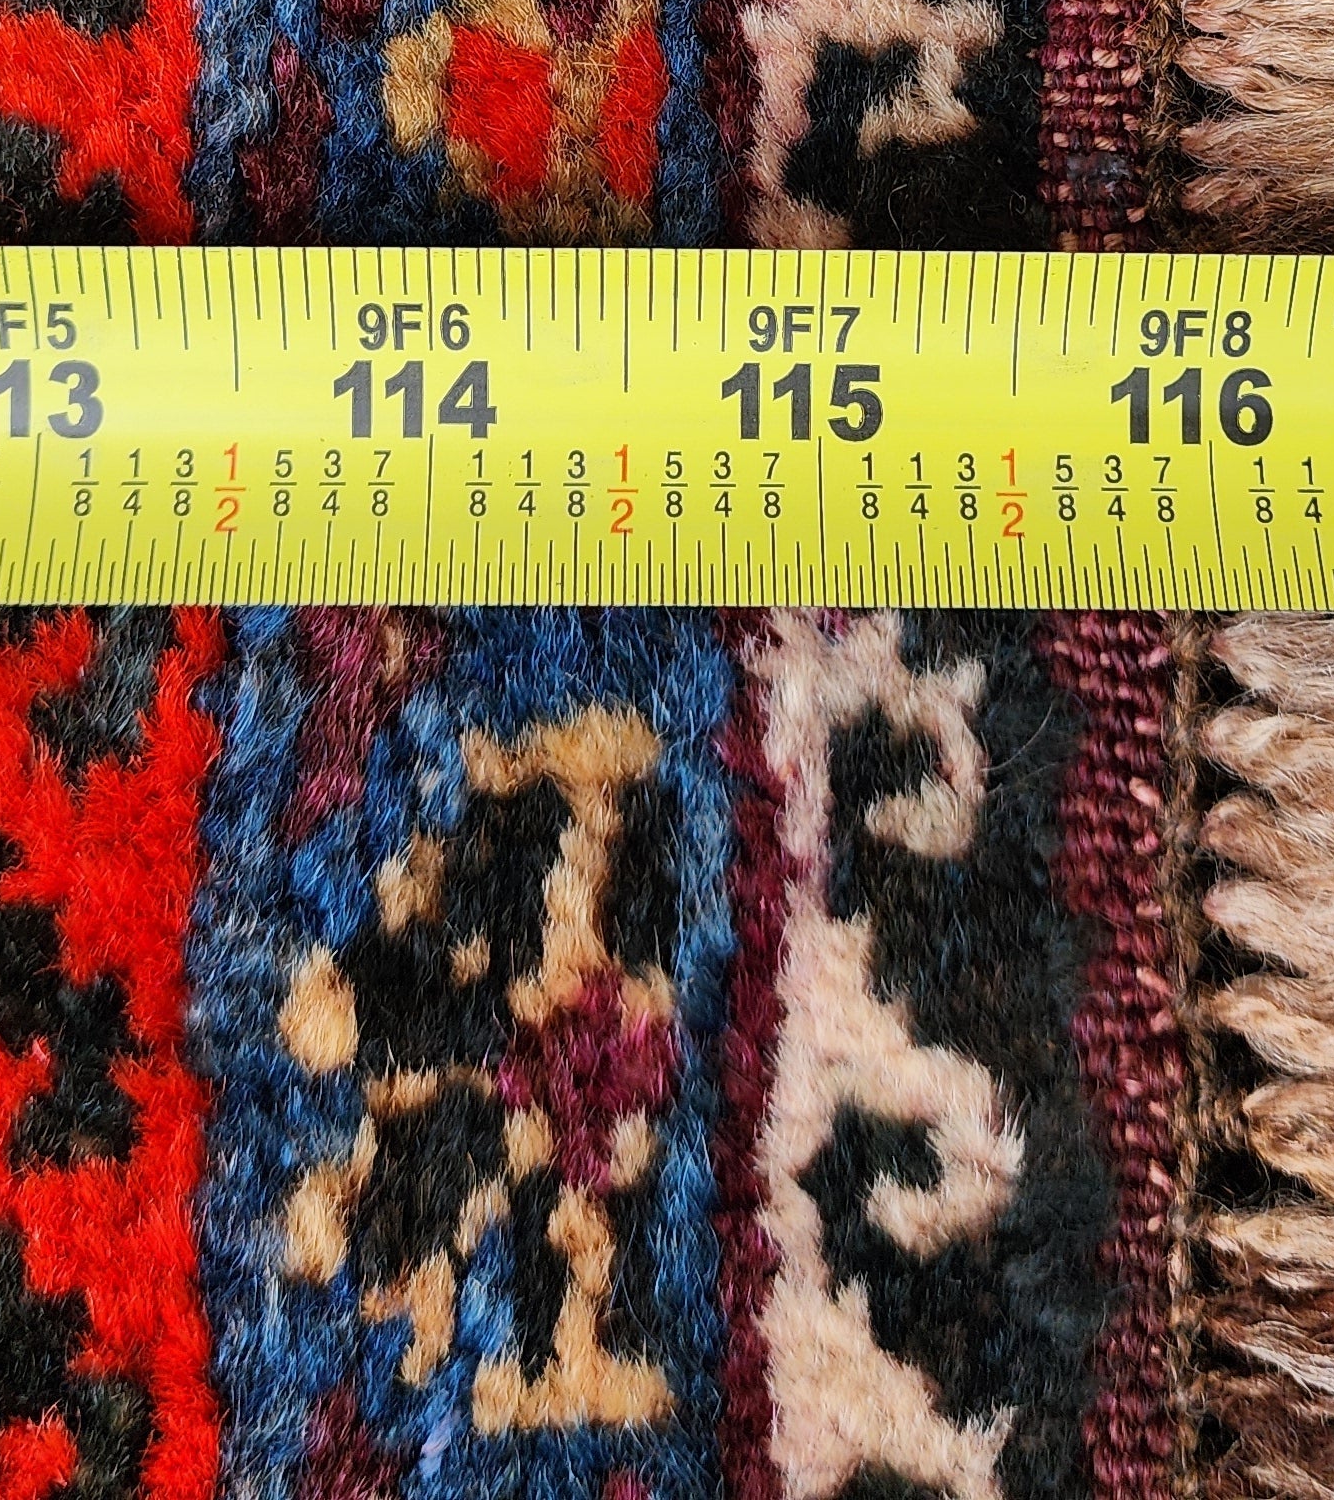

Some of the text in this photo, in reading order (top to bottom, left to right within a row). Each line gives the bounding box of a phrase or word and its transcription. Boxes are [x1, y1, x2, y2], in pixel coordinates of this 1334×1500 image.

[47, 303, 76, 349] 5
[358, 303, 470, 350] 9F 6
[749, 306, 860, 353] 9F 7
[1140, 310, 1252, 357] 9F 8
[334, 360, 497, 439] 114
[722, 363, 883, 442] 115
[1111, 367, 1273, 446] 116
